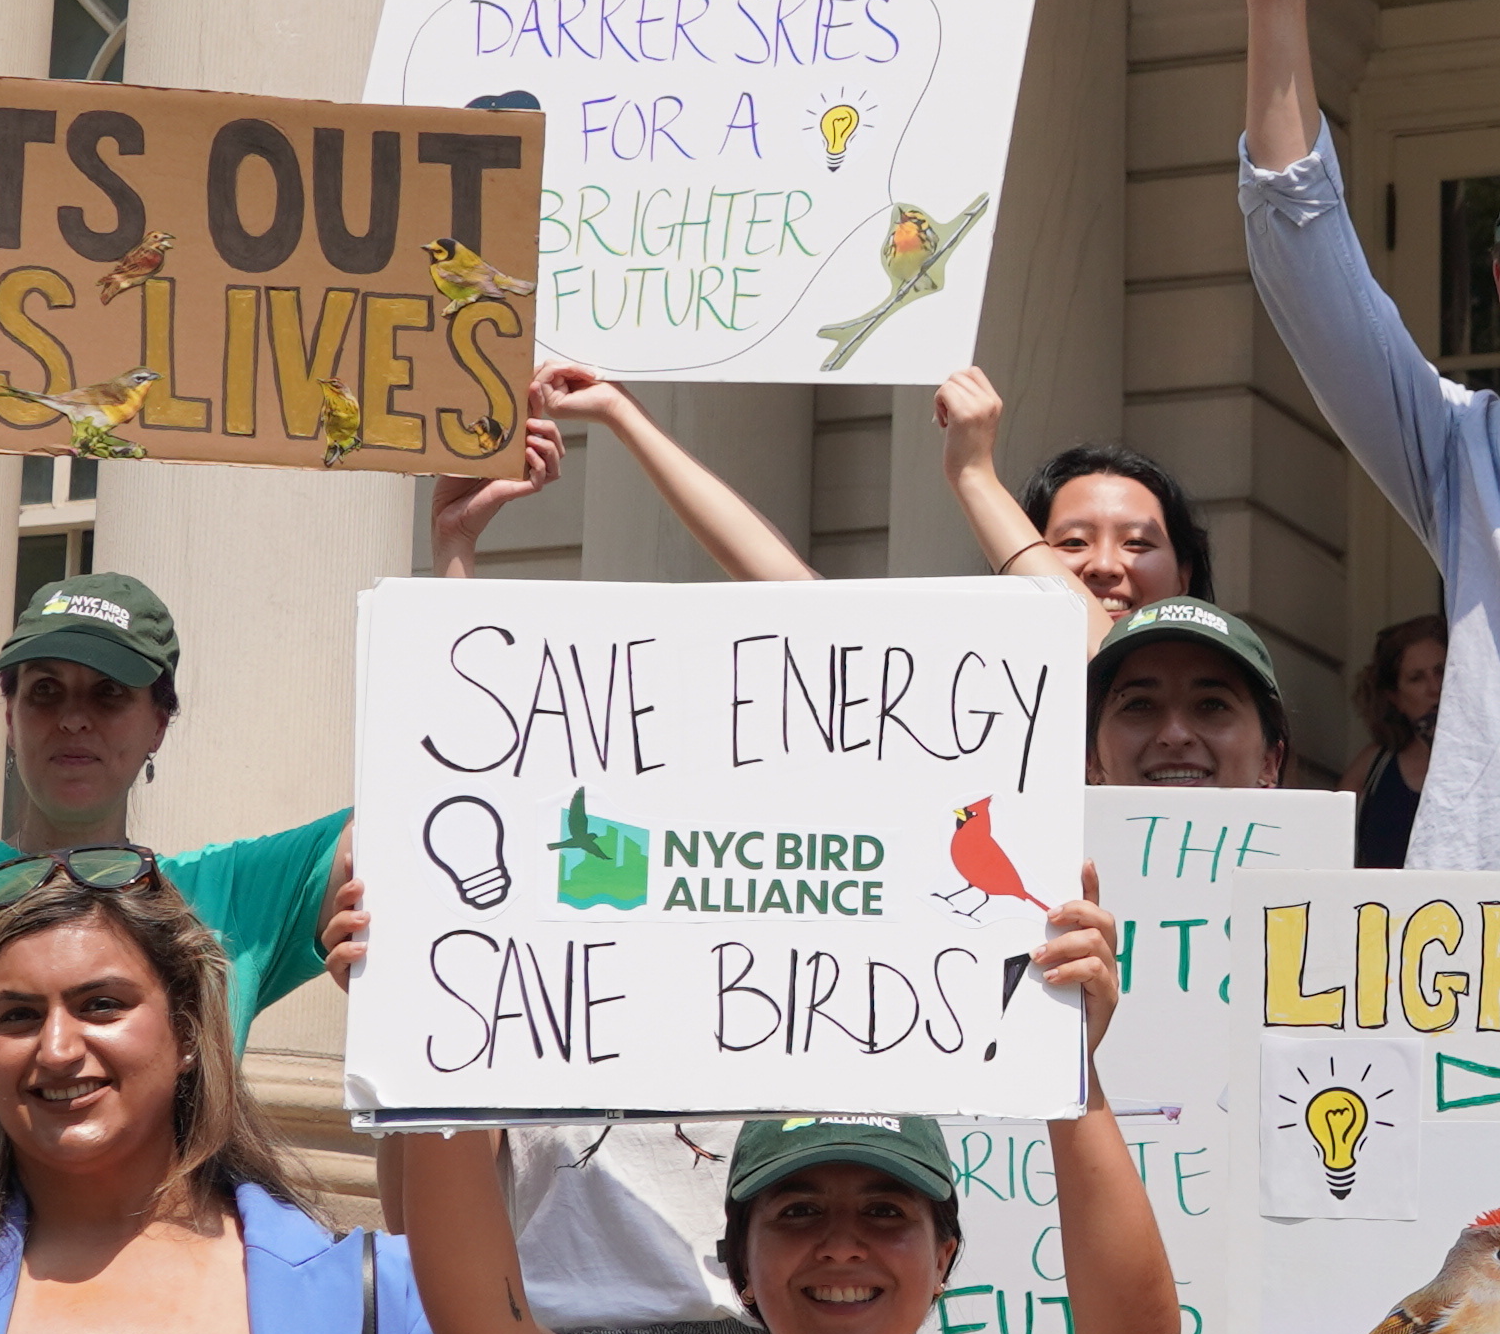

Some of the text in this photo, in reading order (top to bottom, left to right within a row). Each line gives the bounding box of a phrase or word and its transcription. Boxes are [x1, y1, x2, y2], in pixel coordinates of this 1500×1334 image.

[581, 93, 763, 162] FOR A
[207, 118, 521, 275] OUT
[540, 188, 820, 257] BRIGHTER
[554, 267, 763, 331] FUTURE
[140, 277, 522, 459] LIVES
[67, 604, 129, 630] ALLIANCE
[70, 595, 130, 620] NYC BIRD
[1160, 605, 1194, 615] NYC
[421, 625, 1048, 794] SAVE ENERGY
[663, 829, 885, 872] NYC BIRD
[663, 877, 884, 917] ALLIANCE
[426, 929, 627, 1074] SAVE
[712, 942, 1031, 1063] BIRDS!
